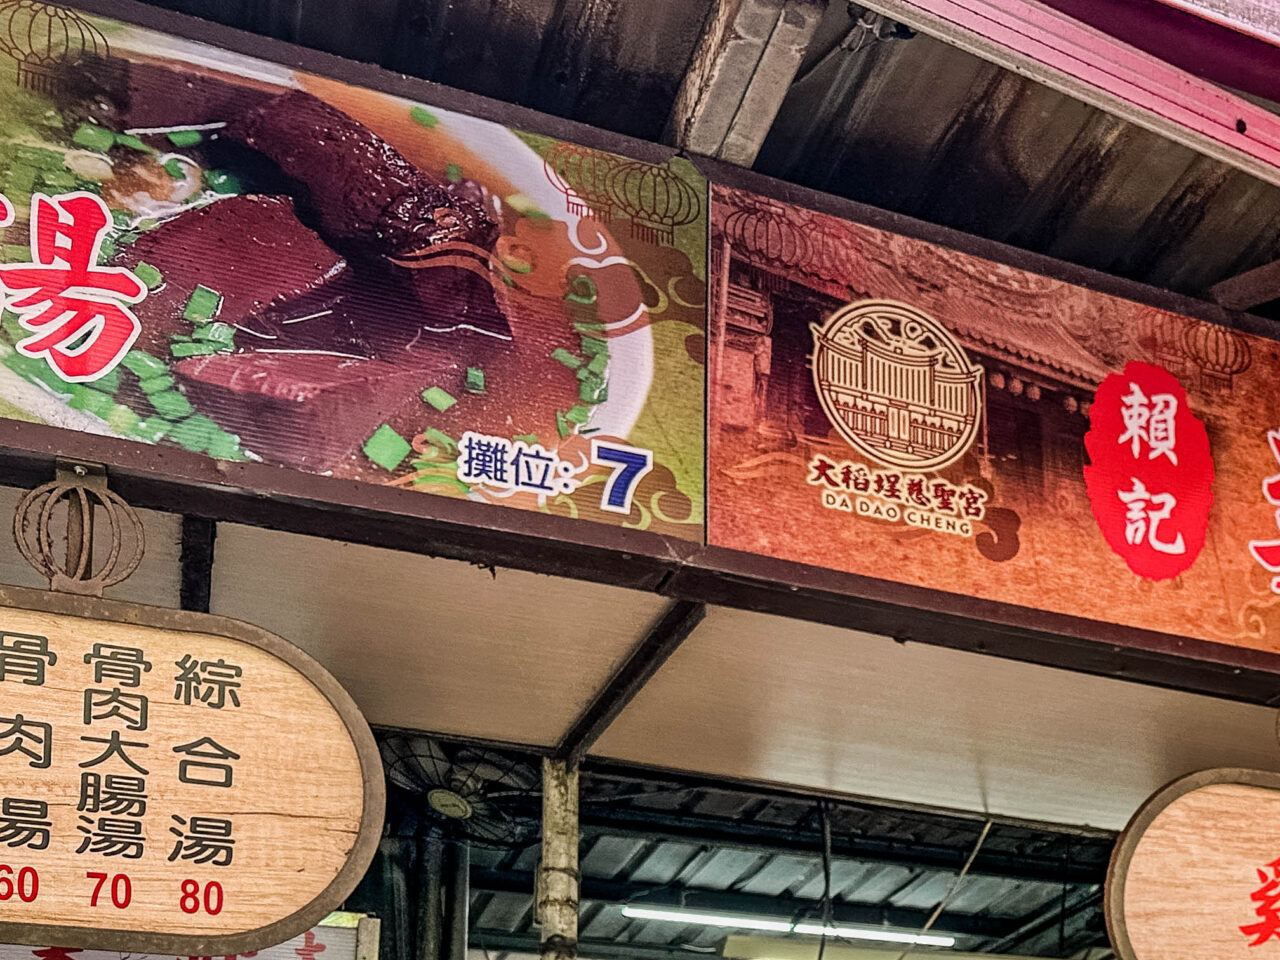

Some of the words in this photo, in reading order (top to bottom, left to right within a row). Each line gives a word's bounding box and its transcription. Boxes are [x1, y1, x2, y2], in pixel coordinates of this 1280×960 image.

[592, 442, 653, 514] 7
[810, 457, 987, 519] 大稻埕慈聖宮
[1117, 382, 1185, 555] 賴記
[822, 492, 853, 514] DA
[856, 499, 900, 523] DAO
[904, 509, 973, 537] CHENG
[75, 642, 152, 859] 骨肉大腸湯
[168, 653, 243, 866] 綜合湯
[0, 864, 39, 904] 60
[86, 871, 132, 909] 70
[179, 879, 224, 916] 80
